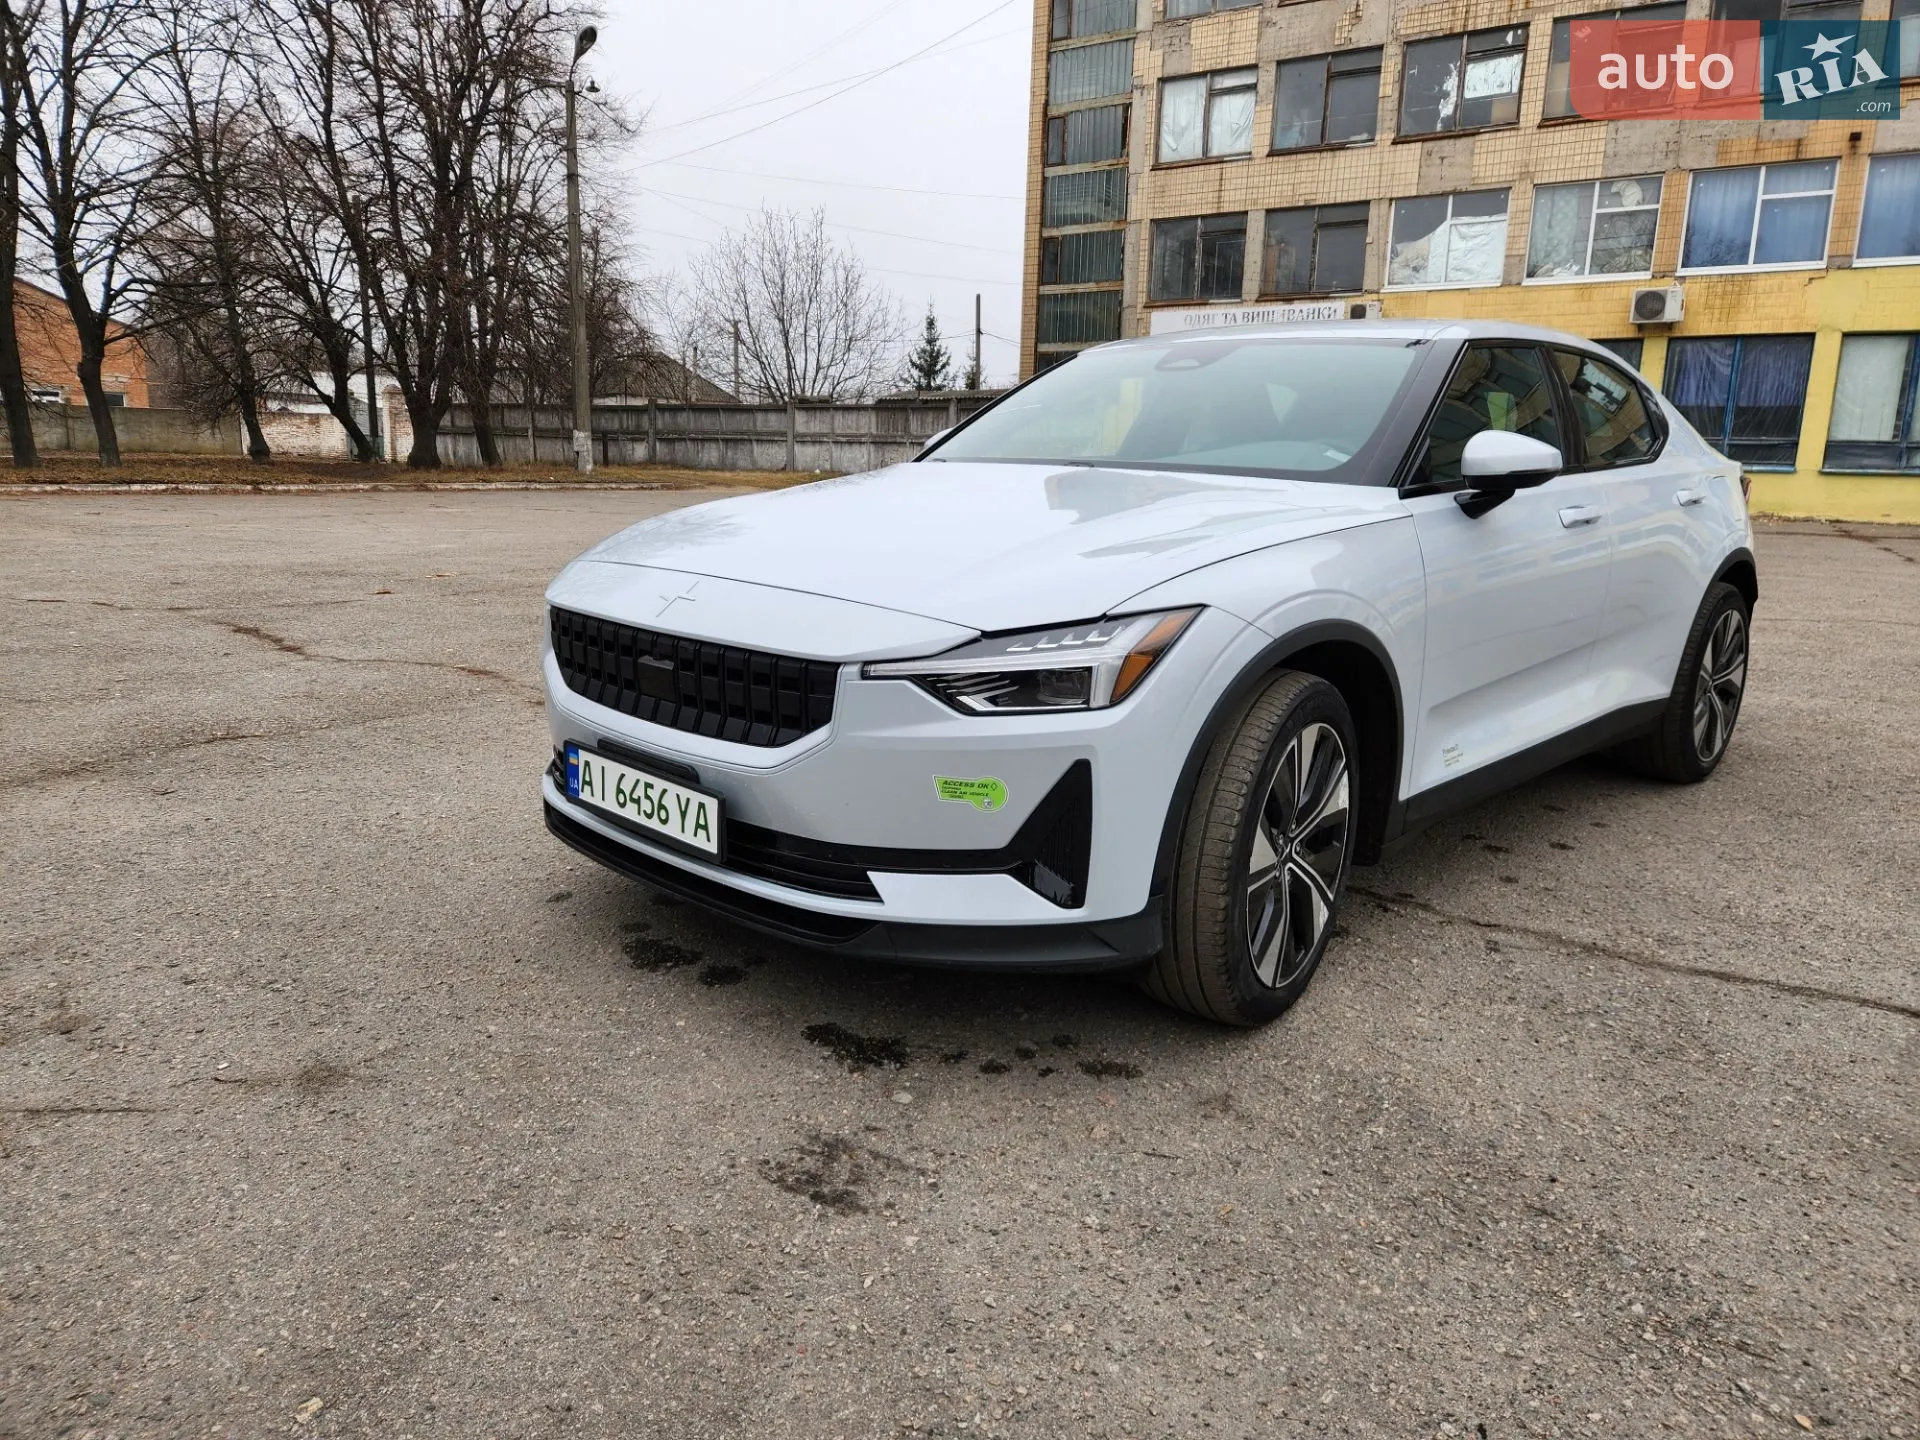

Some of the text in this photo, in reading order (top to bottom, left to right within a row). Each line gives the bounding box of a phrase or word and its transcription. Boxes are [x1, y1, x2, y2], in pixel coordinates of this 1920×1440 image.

[1222, 312, 1238, 325] ТА
[569, 776, 579, 790] UA
[942, 780, 976, 788] ACCESS
[581, 760, 711, 843] AI 6456 YA
